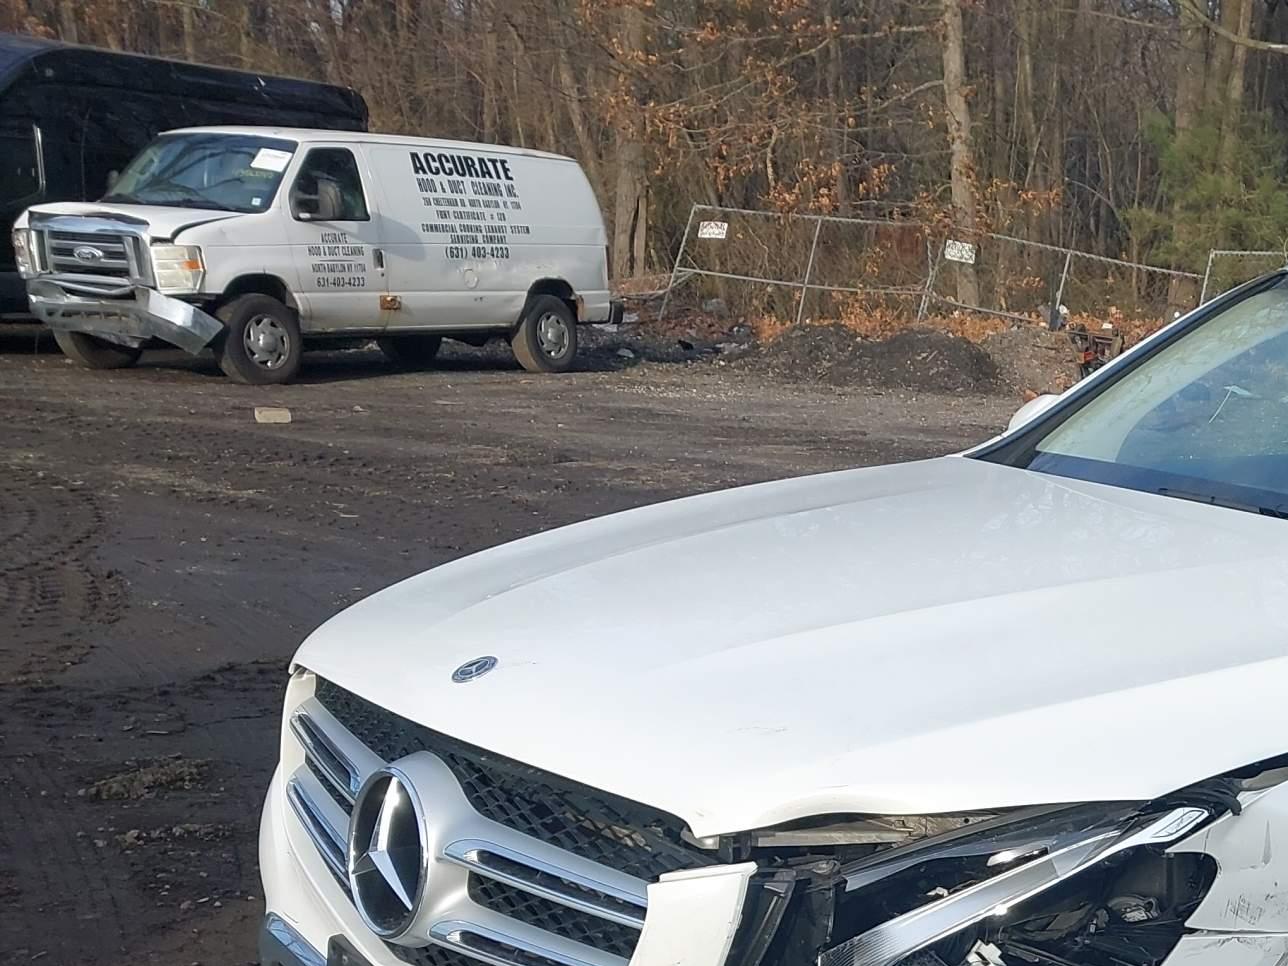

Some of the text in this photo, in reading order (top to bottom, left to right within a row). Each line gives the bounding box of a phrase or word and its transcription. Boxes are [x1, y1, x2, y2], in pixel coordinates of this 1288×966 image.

[409, 151, 514, 181] ACCURATE
[416, 177, 438, 193] HOOD
[447, 179, 467, 195] DUCT
[470, 180, 504, 197] CLEANING
[421, 223, 531, 235] COMMERCIAL COOKING EXHAUST SYSTEM
[450, 234, 508, 245] SERVICING COMPANY
[445, 246, 510, 260] (631) 403-4233
[316, 276, 365, 288] 631-403-4233
